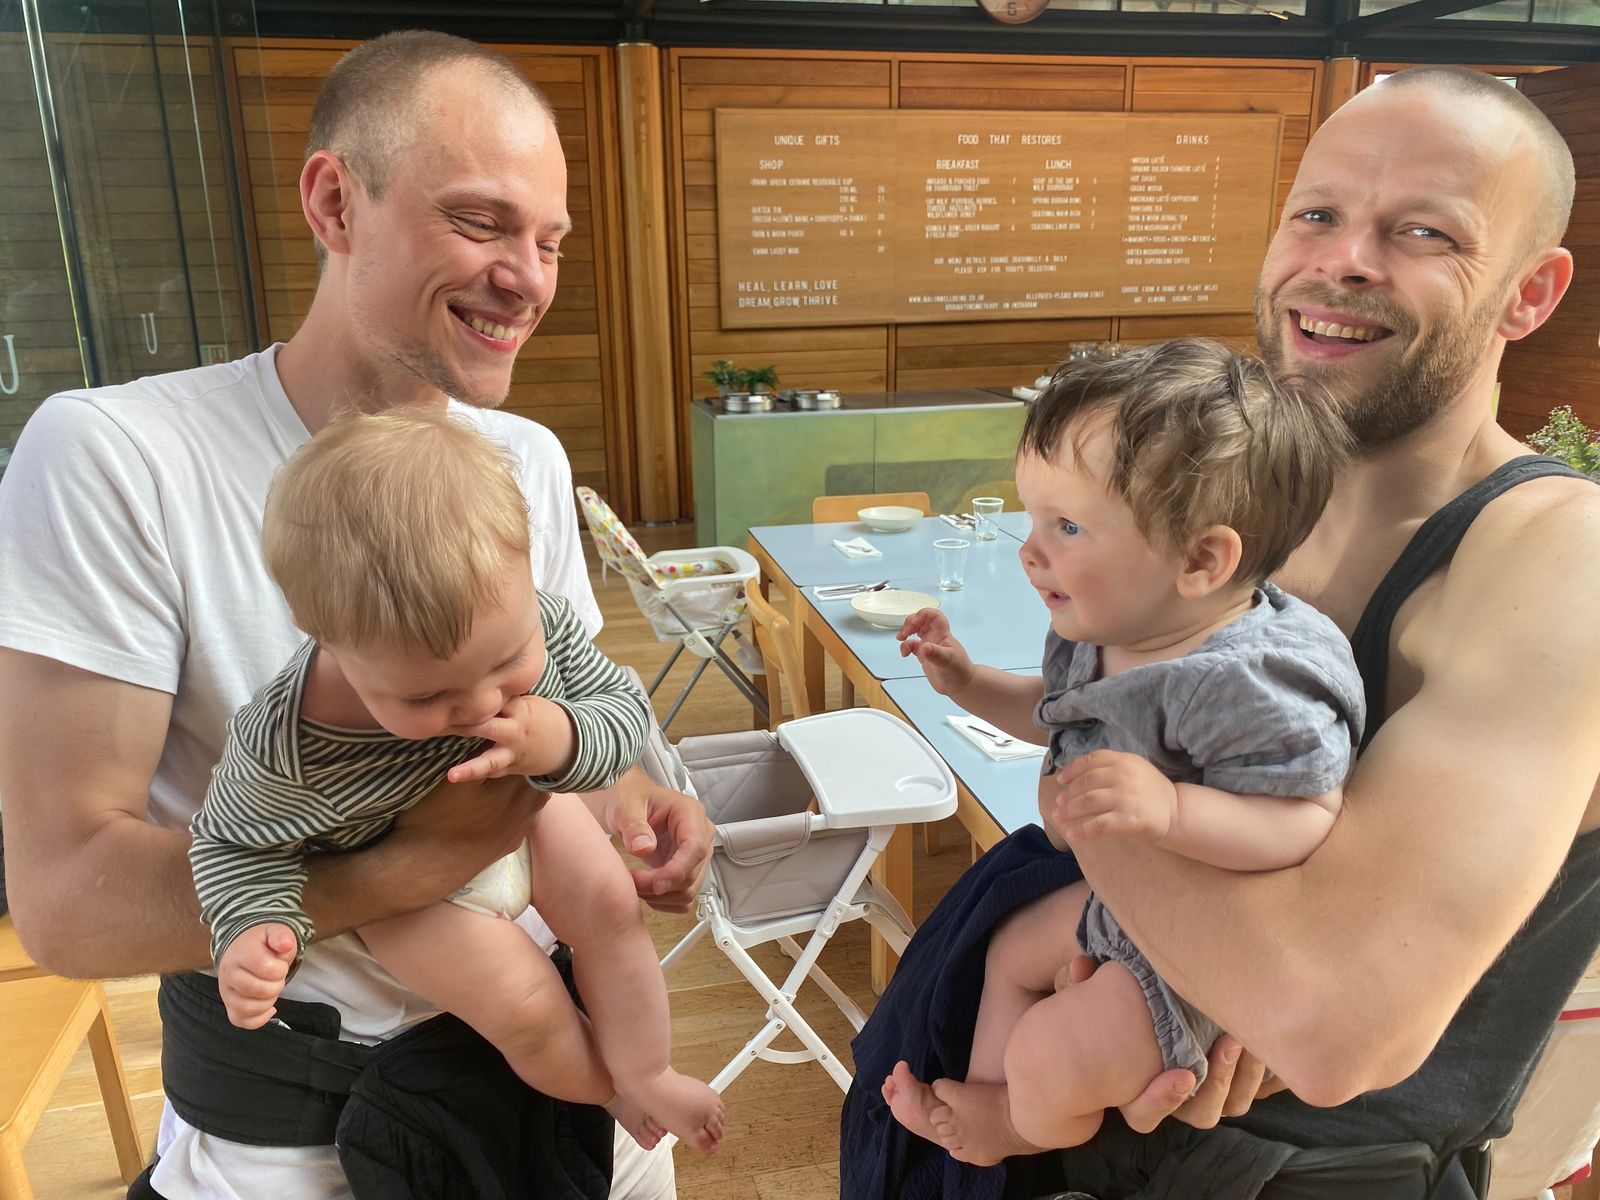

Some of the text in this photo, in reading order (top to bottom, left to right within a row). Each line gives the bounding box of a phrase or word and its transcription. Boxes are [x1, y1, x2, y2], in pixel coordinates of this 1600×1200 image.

[774, 135, 840, 145] UNIQUE GIFTS
[957, 134, 1062, 145] FOOD THAT RESTORES
[1175, 135, 1209, 144] DRINKS
[758, 160, 784, 170] SHOP
[936, 160, 980, 170] BREAKFAST
[1045, 160, 1072, 170] LUNCH
[814, 280, 838, 290] LOVE
[803, 296, 838, 306] THRIVE
